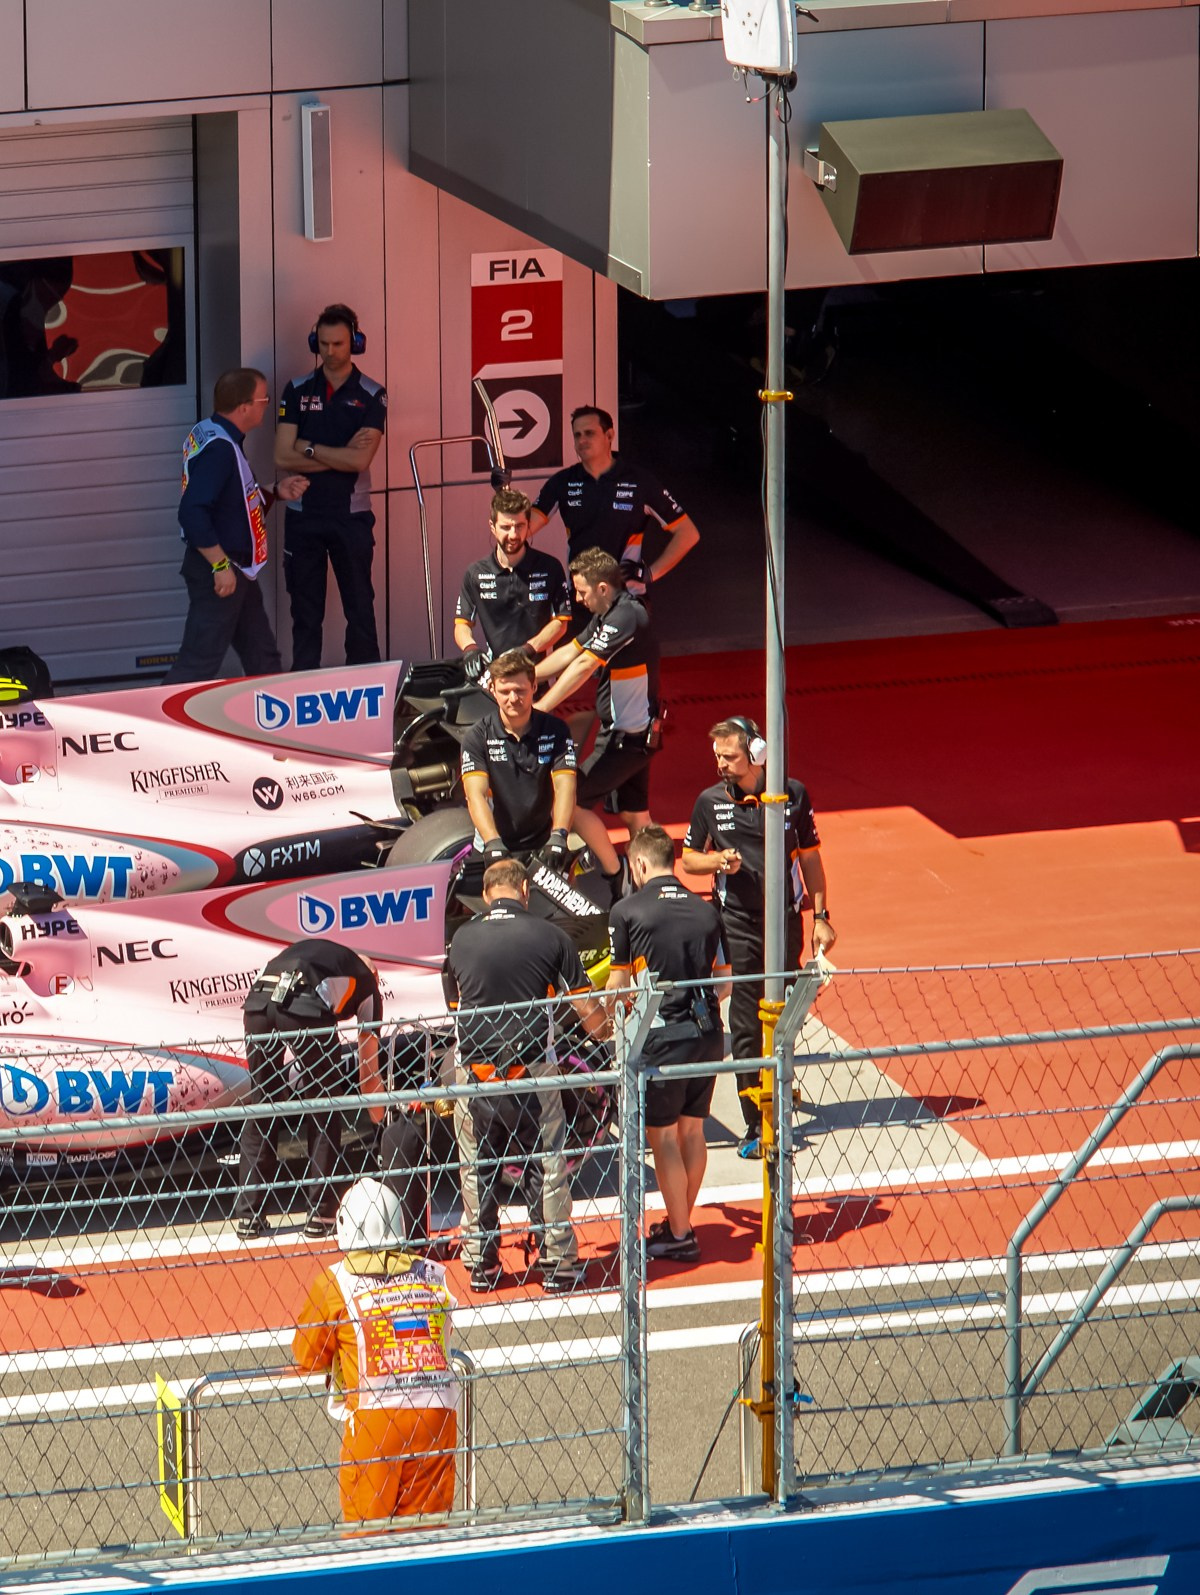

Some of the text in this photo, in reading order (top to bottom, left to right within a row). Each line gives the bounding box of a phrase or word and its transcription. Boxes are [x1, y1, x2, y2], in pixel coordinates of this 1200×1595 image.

[489, 257, 545, 281] FIA
[500, 308, 533, 341] 2
[480, 592, 498, 600] NEC
[296, 685, 385, 727] BWT
[61, 732, 140, 757] NEC
[489, 754, 508, 762] NEC
[21, 765, 35, 784] E
[130, 761, 230, 794] KINGFISHER
[285, 771, 339, 791] 利来国际
[163, 786, 205, 799] PREMIUM
[291, 785, 346, 804] W66.COM
[717, 822, 736, 831] NEC
[271, 838, 321, 868] FXTM
[20, 854, 134, 899] BWT
[340, 886, 434, 930] BWT
[21, 919, 80, 940] HYPE
[96, 938, 179, 967] NEC
[55, 976, 68, 995] E
[55, 1070, 174, 1115] BWT
[28, 1154, 56, 1163] UNIVA
[67, 1149, 117, 1165] BARBADOS
